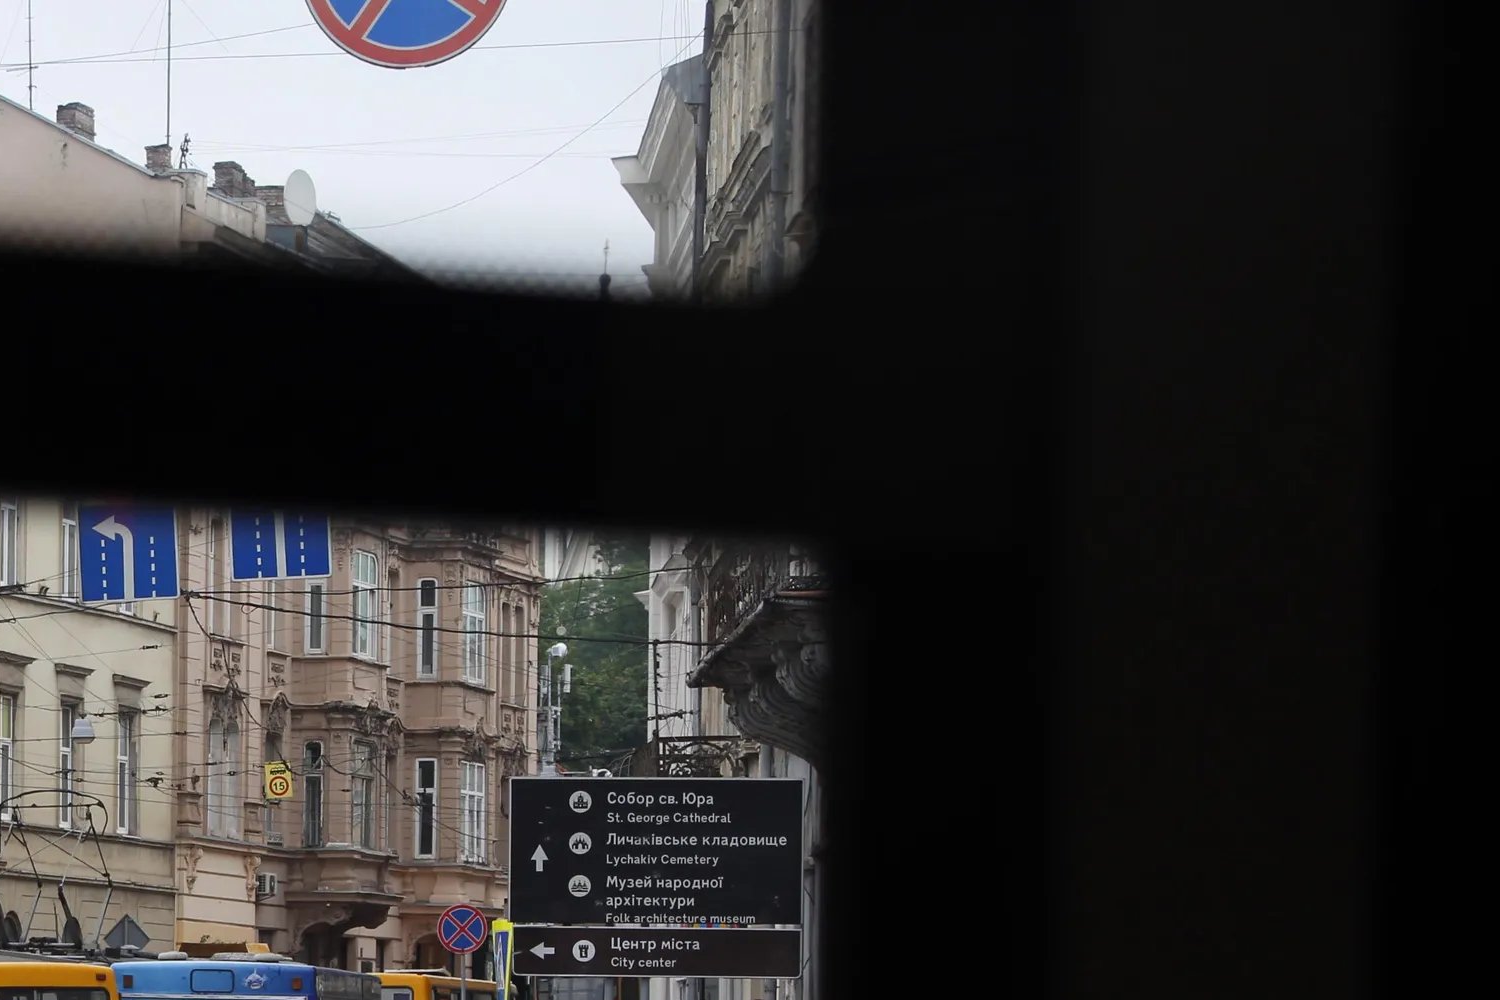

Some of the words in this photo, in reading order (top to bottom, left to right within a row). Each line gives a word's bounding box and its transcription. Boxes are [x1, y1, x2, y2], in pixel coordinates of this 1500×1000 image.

[273, 781, 285, 791] 15
[607, 791, 654, 807] Собор
[659, 794, 678, 805] св.
[682, 792, 714, 807] Юра
[607, 812, 623, 823] St.
[627, 812, 670, 825] George
[673, 812, 731, 824] Cathedral
[606, 832, 697, 846] Личаківське
[702, 836, 787, 847] кладовище
[606, 854, 657, 866] Lychakiv
[660, 854, 719, 867] Cemetery
[606, 875, 652, 891] Музей
[656, 876, 724, 891] народної
[606, 894, 695, 909] архітектури
[605, 913, 630, 923] Folk
[633, 913, 707, 924] architecture
[710, 914, 756, 924] museum
[610, 937, 656, 953] Центр
[661, 937, 700, 950] міста
[610, 956, 635, 970] City
[638, 958, 677, 968] center
